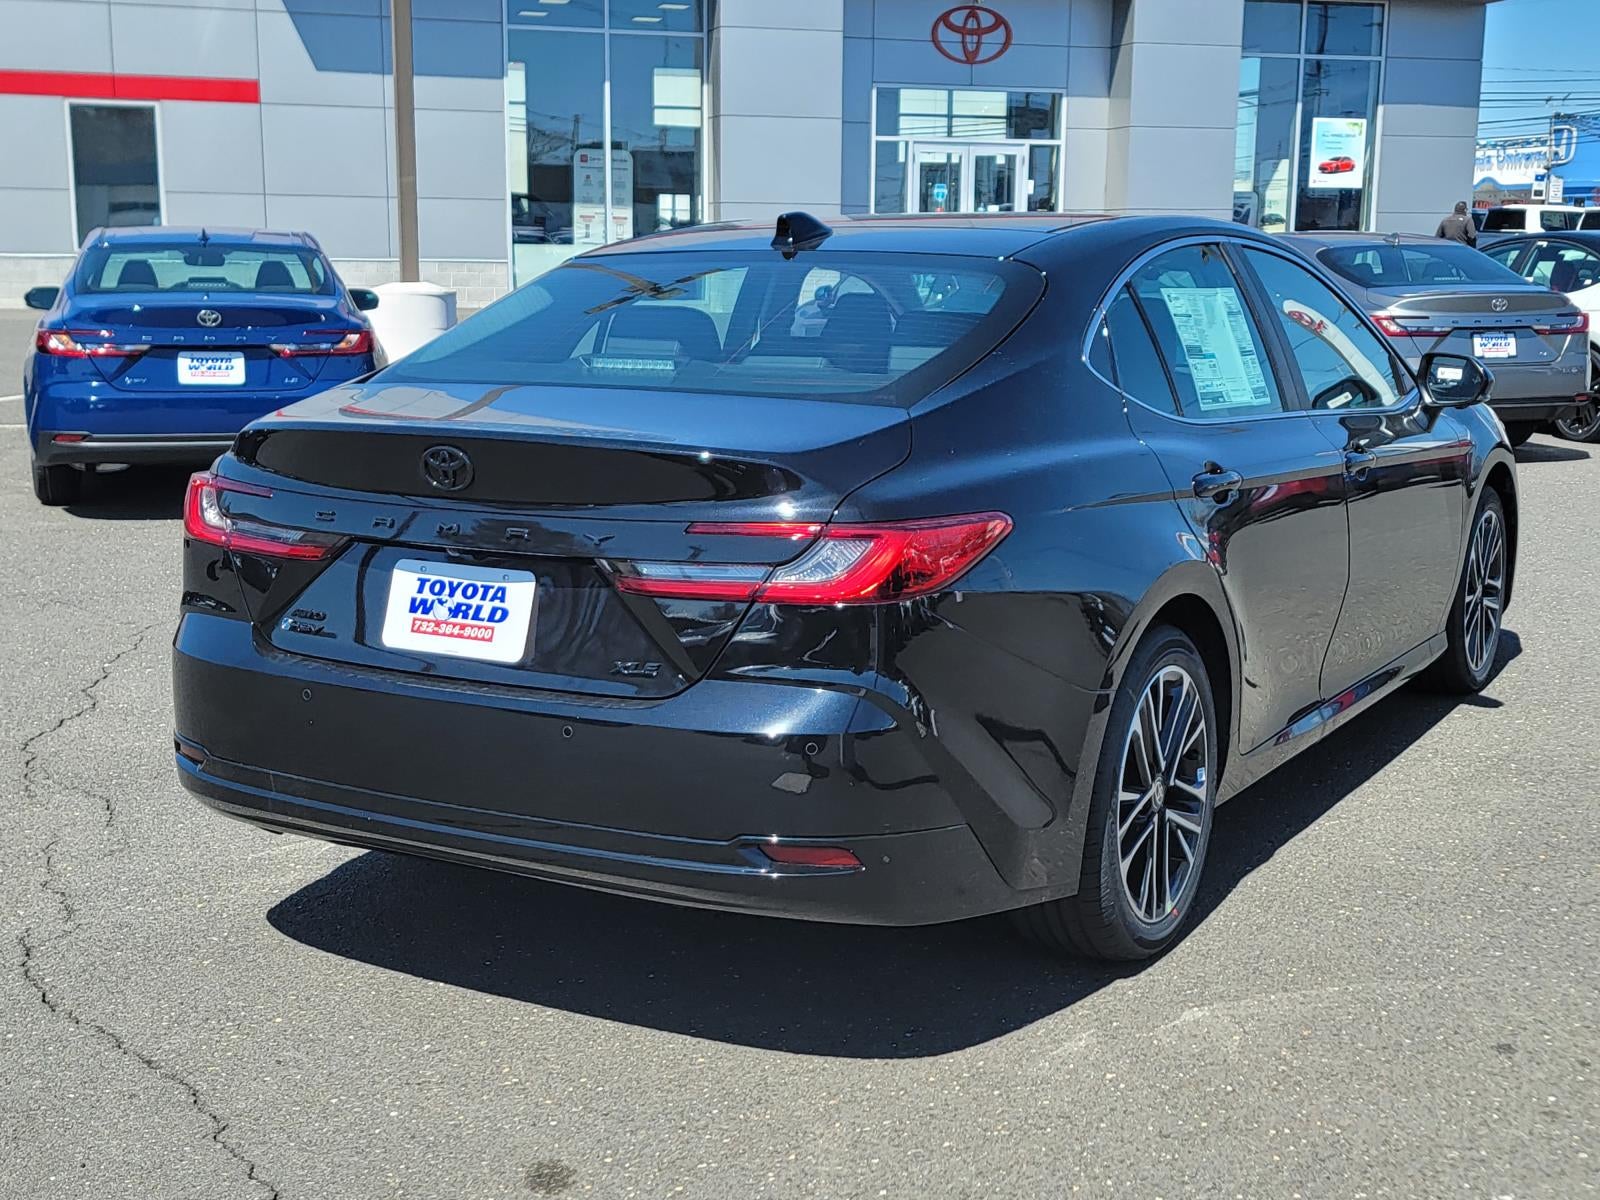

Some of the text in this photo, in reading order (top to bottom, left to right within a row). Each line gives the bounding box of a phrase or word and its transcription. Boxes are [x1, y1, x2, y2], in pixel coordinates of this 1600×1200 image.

[189, 356, 232, 364] TOYOTA
[314, 510, 616, 545] CAMRY
[416, 577, 507, 604] TOYOTA
[408, 597, 510, 624] WORLD
[412, 619, 493, 640] 732-364-9000
[610, 660, 662, 678] XLE
